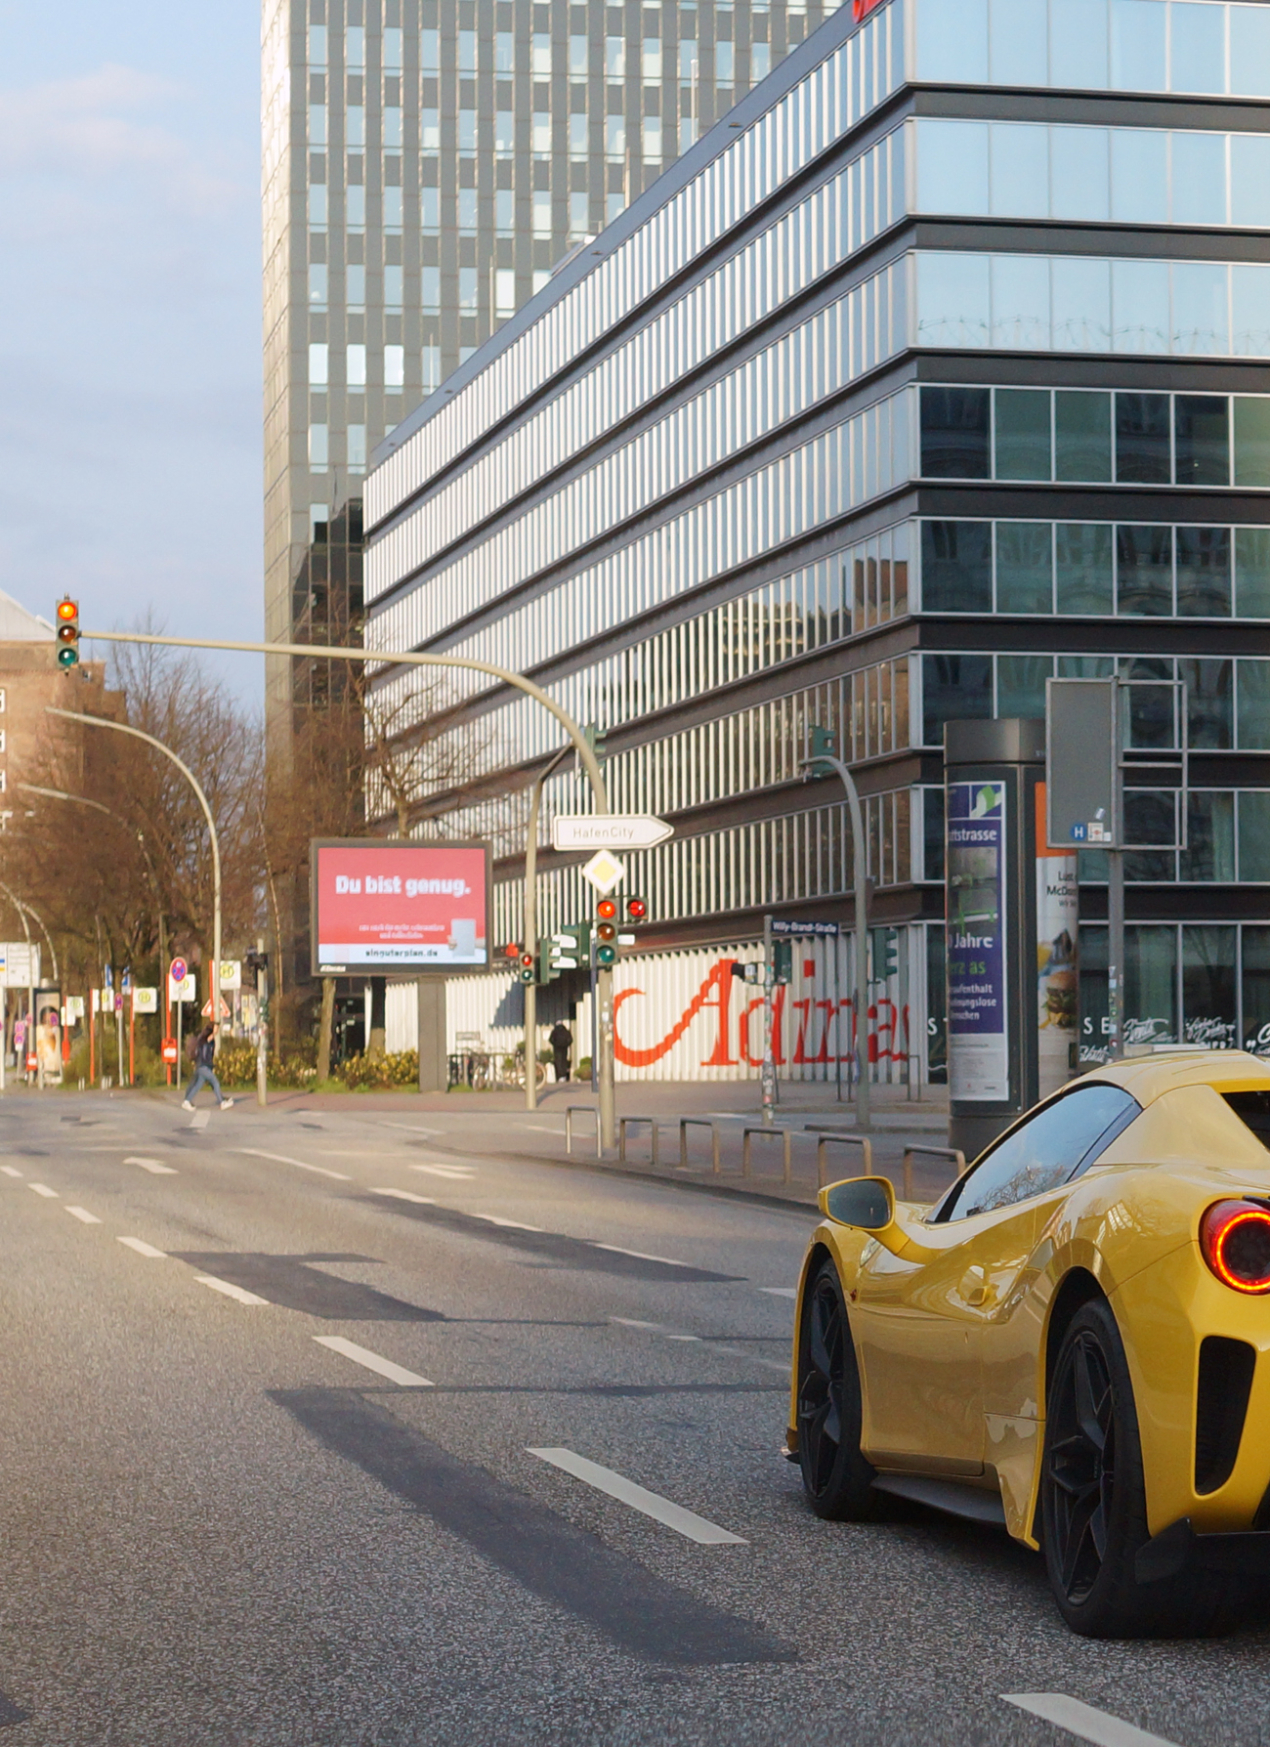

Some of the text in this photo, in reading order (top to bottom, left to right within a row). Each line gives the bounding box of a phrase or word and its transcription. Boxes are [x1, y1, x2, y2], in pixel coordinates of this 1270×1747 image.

[573, 826, 634, 840] HafenCity
[336, 875, 471, 898] Du bist genug.
[954, 932, 993, 949] Jahre
